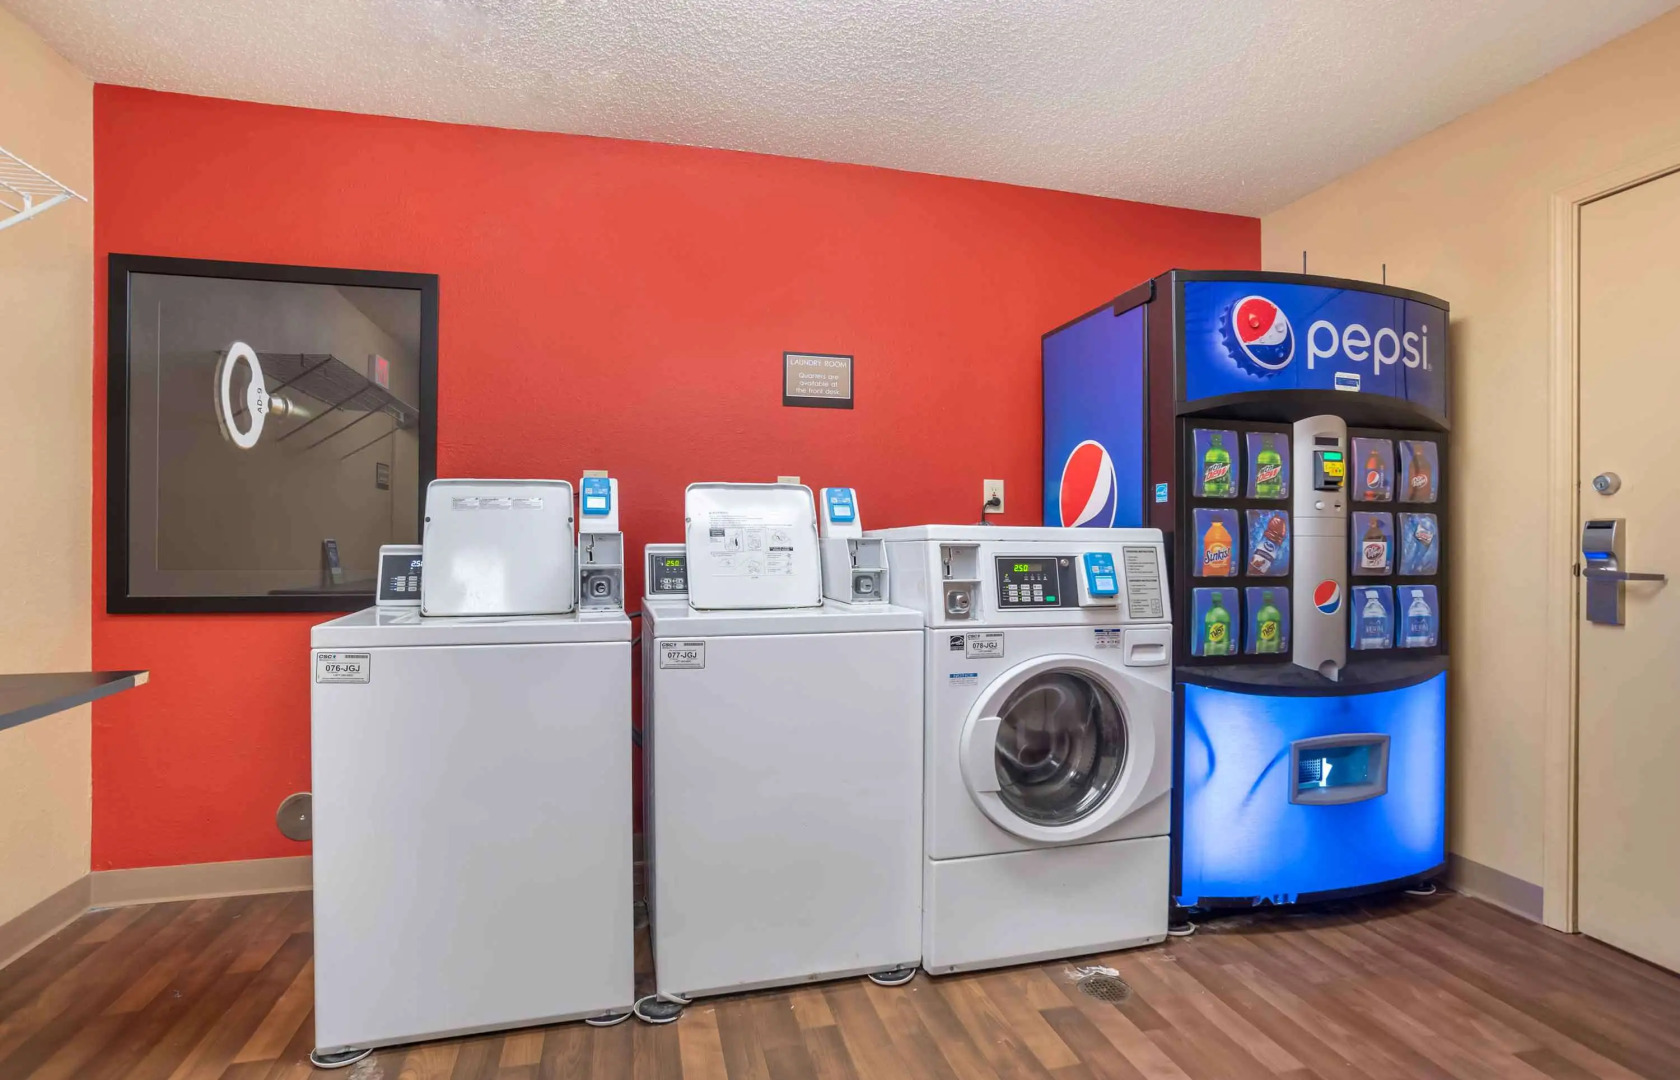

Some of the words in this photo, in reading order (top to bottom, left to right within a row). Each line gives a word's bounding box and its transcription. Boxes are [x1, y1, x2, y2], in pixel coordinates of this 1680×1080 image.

[1307, 319, 1428, 376] pepsi
[790, 359, 821, 367] LAUNDRY
[824, 360, 847, 368] ROOM
[798, 372, 826, 380] Quarters
[799, 380, 829, 388] available
[667, 651, 697, 659] 077-JGJ
[325, 664, 361, 672] 076-JGJ
